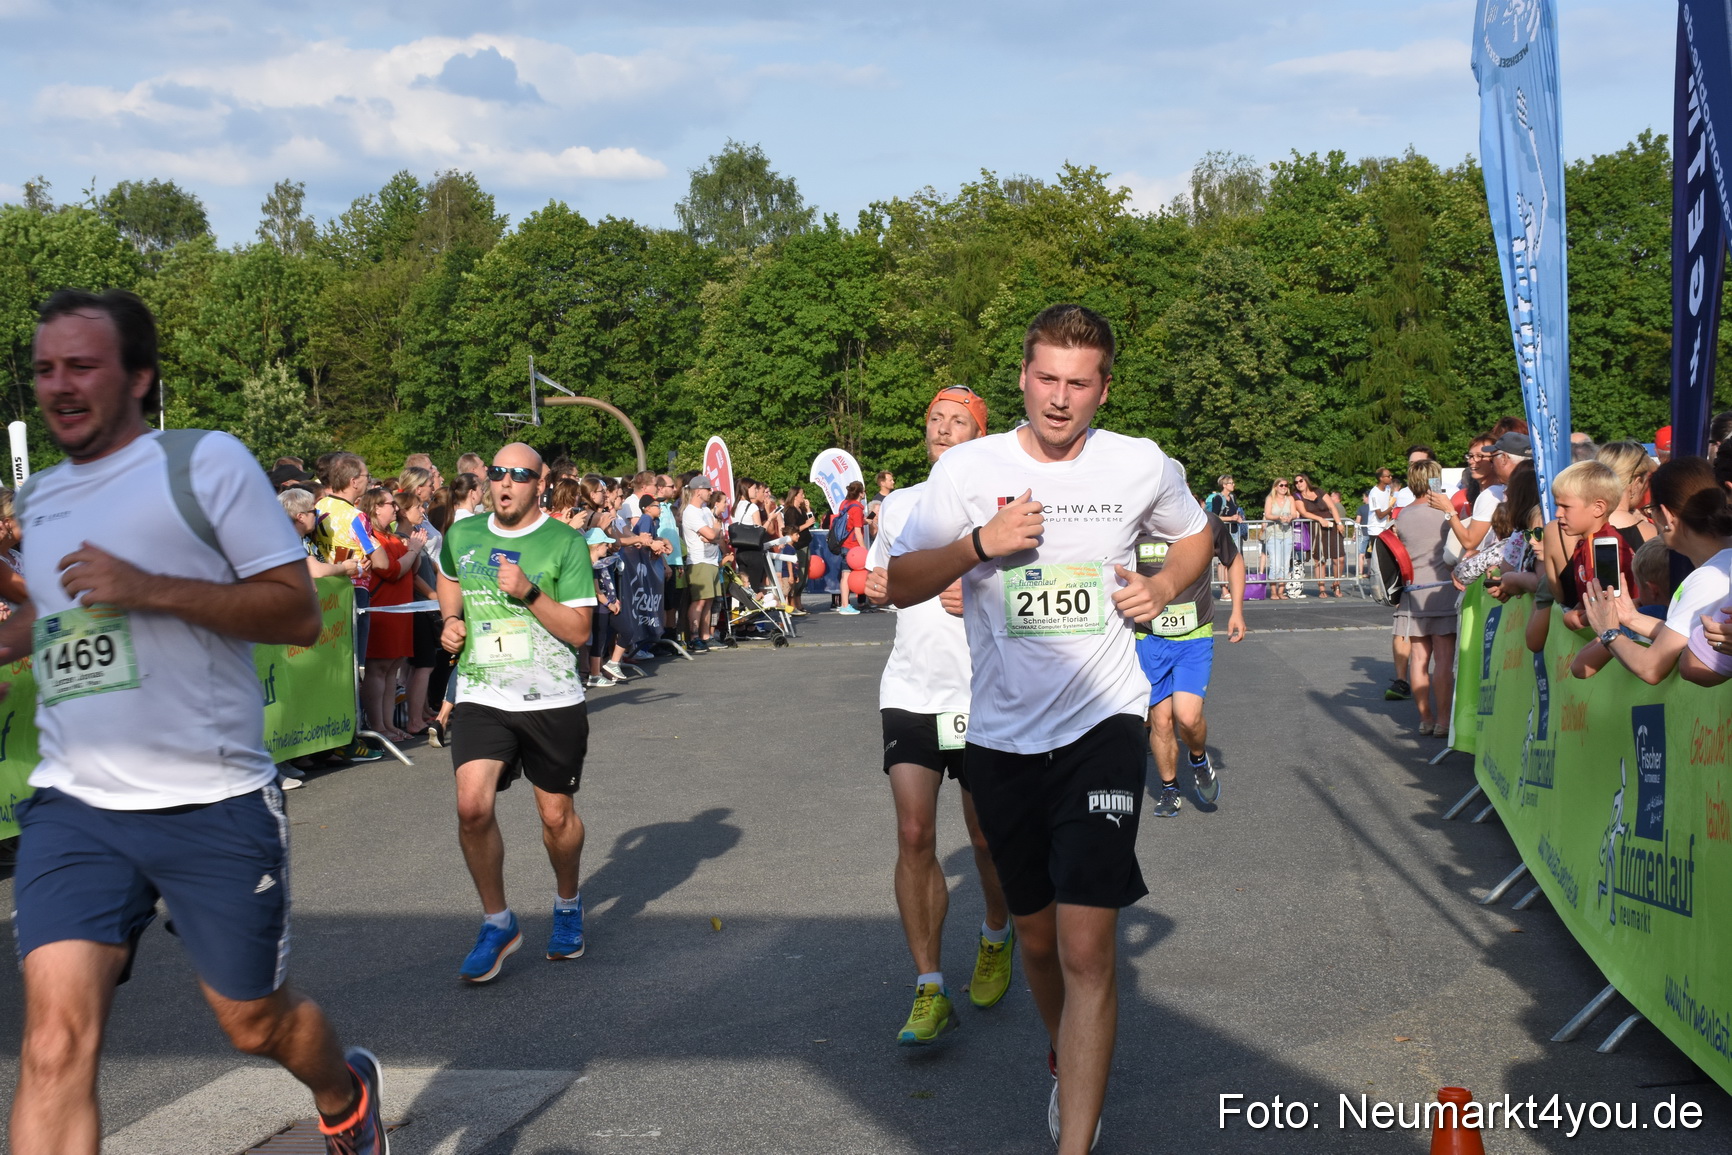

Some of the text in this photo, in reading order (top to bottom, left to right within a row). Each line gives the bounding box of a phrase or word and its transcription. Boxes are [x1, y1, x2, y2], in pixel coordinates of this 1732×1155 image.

[1043, 504, 1123, 514] CHWARZ
[1079, 581, 1097, 589] 2019
[1017, 589, 1090, 616] 2150
[1161, 615, 1186, 627] 291
[494, 636, 503, 653] 1
[41, 634, 116, 679] 1469
[1641, 746, 1662, 769] Fischer
[1089, 794, 1134, 812] PUMA
[1620, 823, 1695, 915] firmenlauf
[1620, 905, 1651, 934] neumarkt
